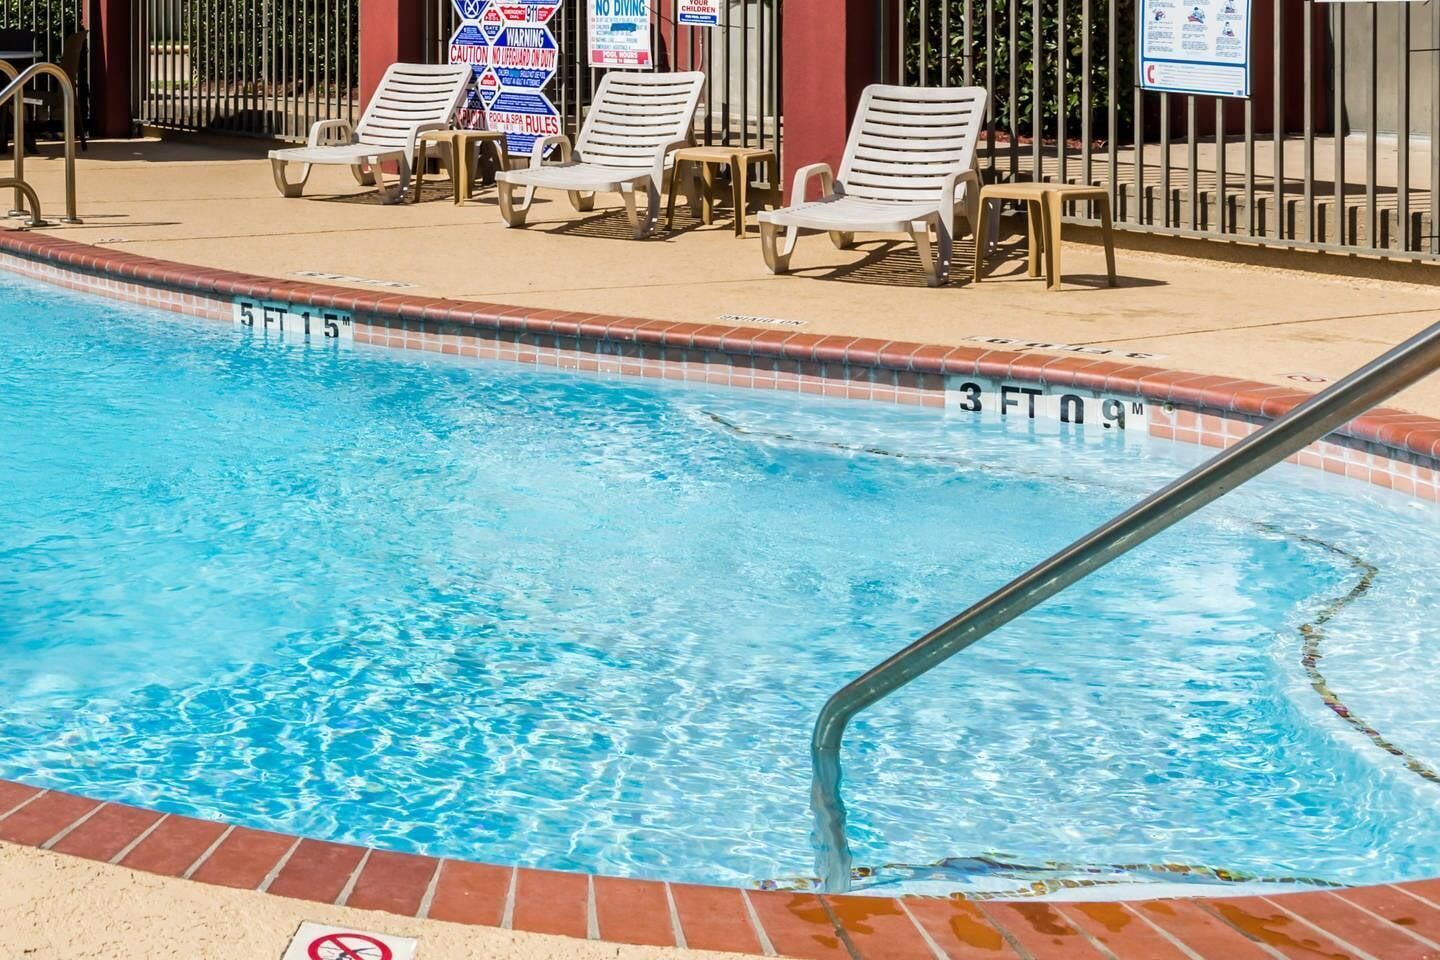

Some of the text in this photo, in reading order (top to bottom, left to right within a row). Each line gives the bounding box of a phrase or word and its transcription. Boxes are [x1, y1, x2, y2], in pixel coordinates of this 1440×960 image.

[526, 5, 538, 23] 911
[681, 5, 716, 14] CHILDREN
[506, 28, 544, 48] WARNING
[450, 45, 488, 63] CAUTION
[492, 48, 557, 68] NO LIFEGUARD ON DUTY
[489, 112, 505, 123] POOL
[510, 113, 523, 124] SPA
[525, 115, 559, 135] RULES
[240, 302, 254, 328] 5
[263, 306, 288, 332] FT
[959, 381, 983, 413] 3
[1001, 385, 1043, 419] FT
